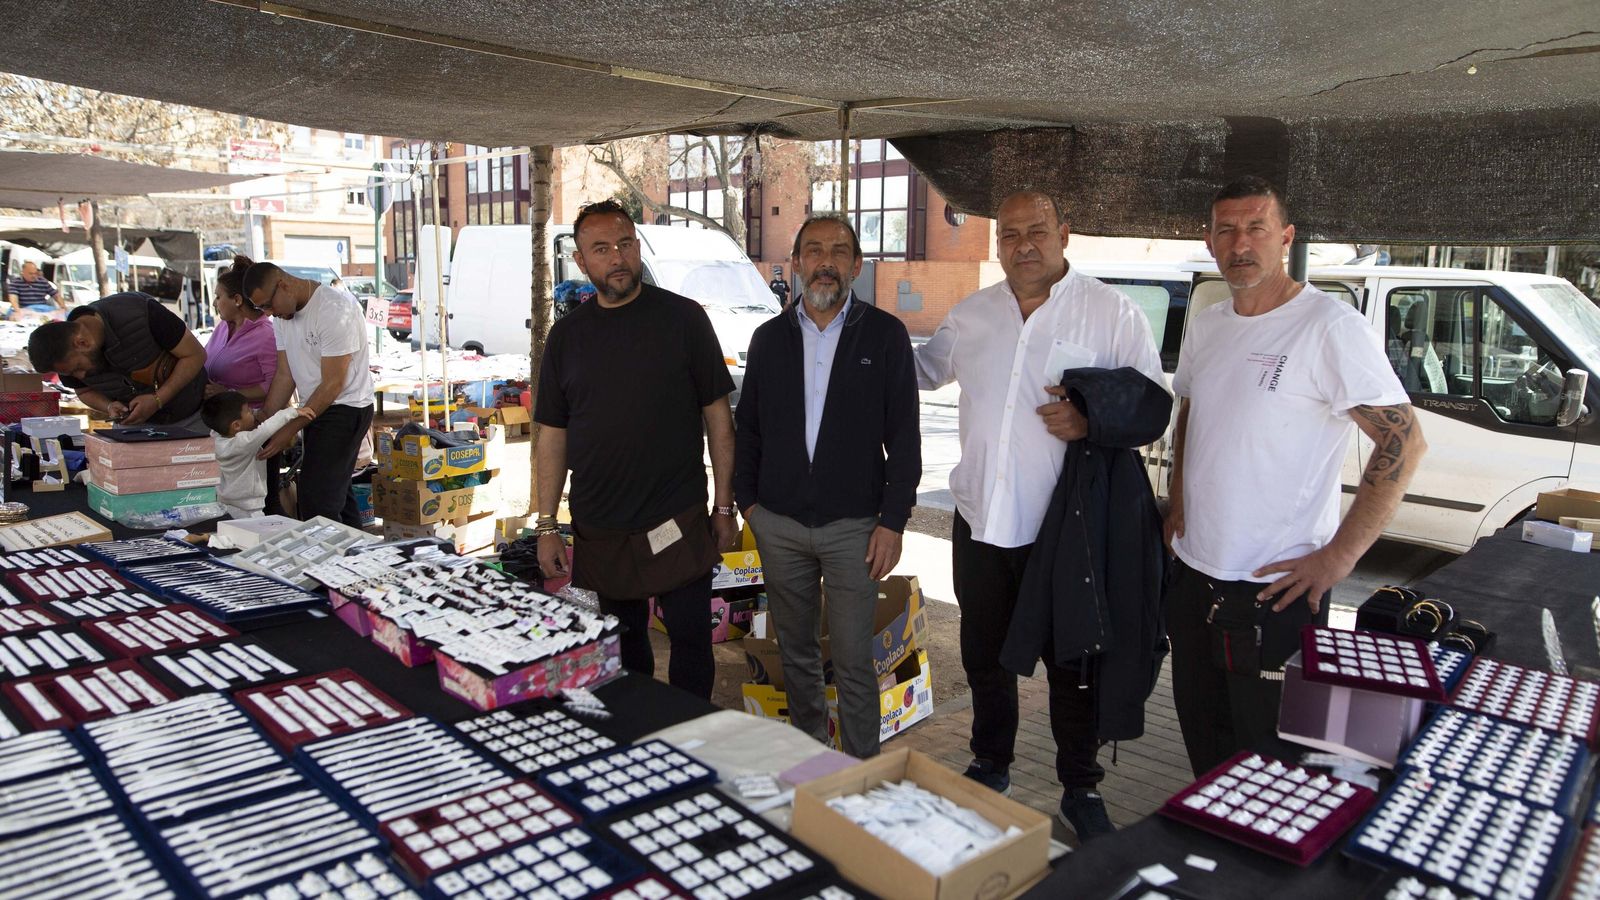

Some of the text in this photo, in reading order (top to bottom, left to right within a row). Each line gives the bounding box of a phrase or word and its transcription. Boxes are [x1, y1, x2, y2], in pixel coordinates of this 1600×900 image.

[1267, 355, 1288, 392] CHANGE
[1422, 399, 1479, 411] TRANSIT
[733, 566, 763, 576] Coplaca
[876, 644, 905, 675] Coplaca
